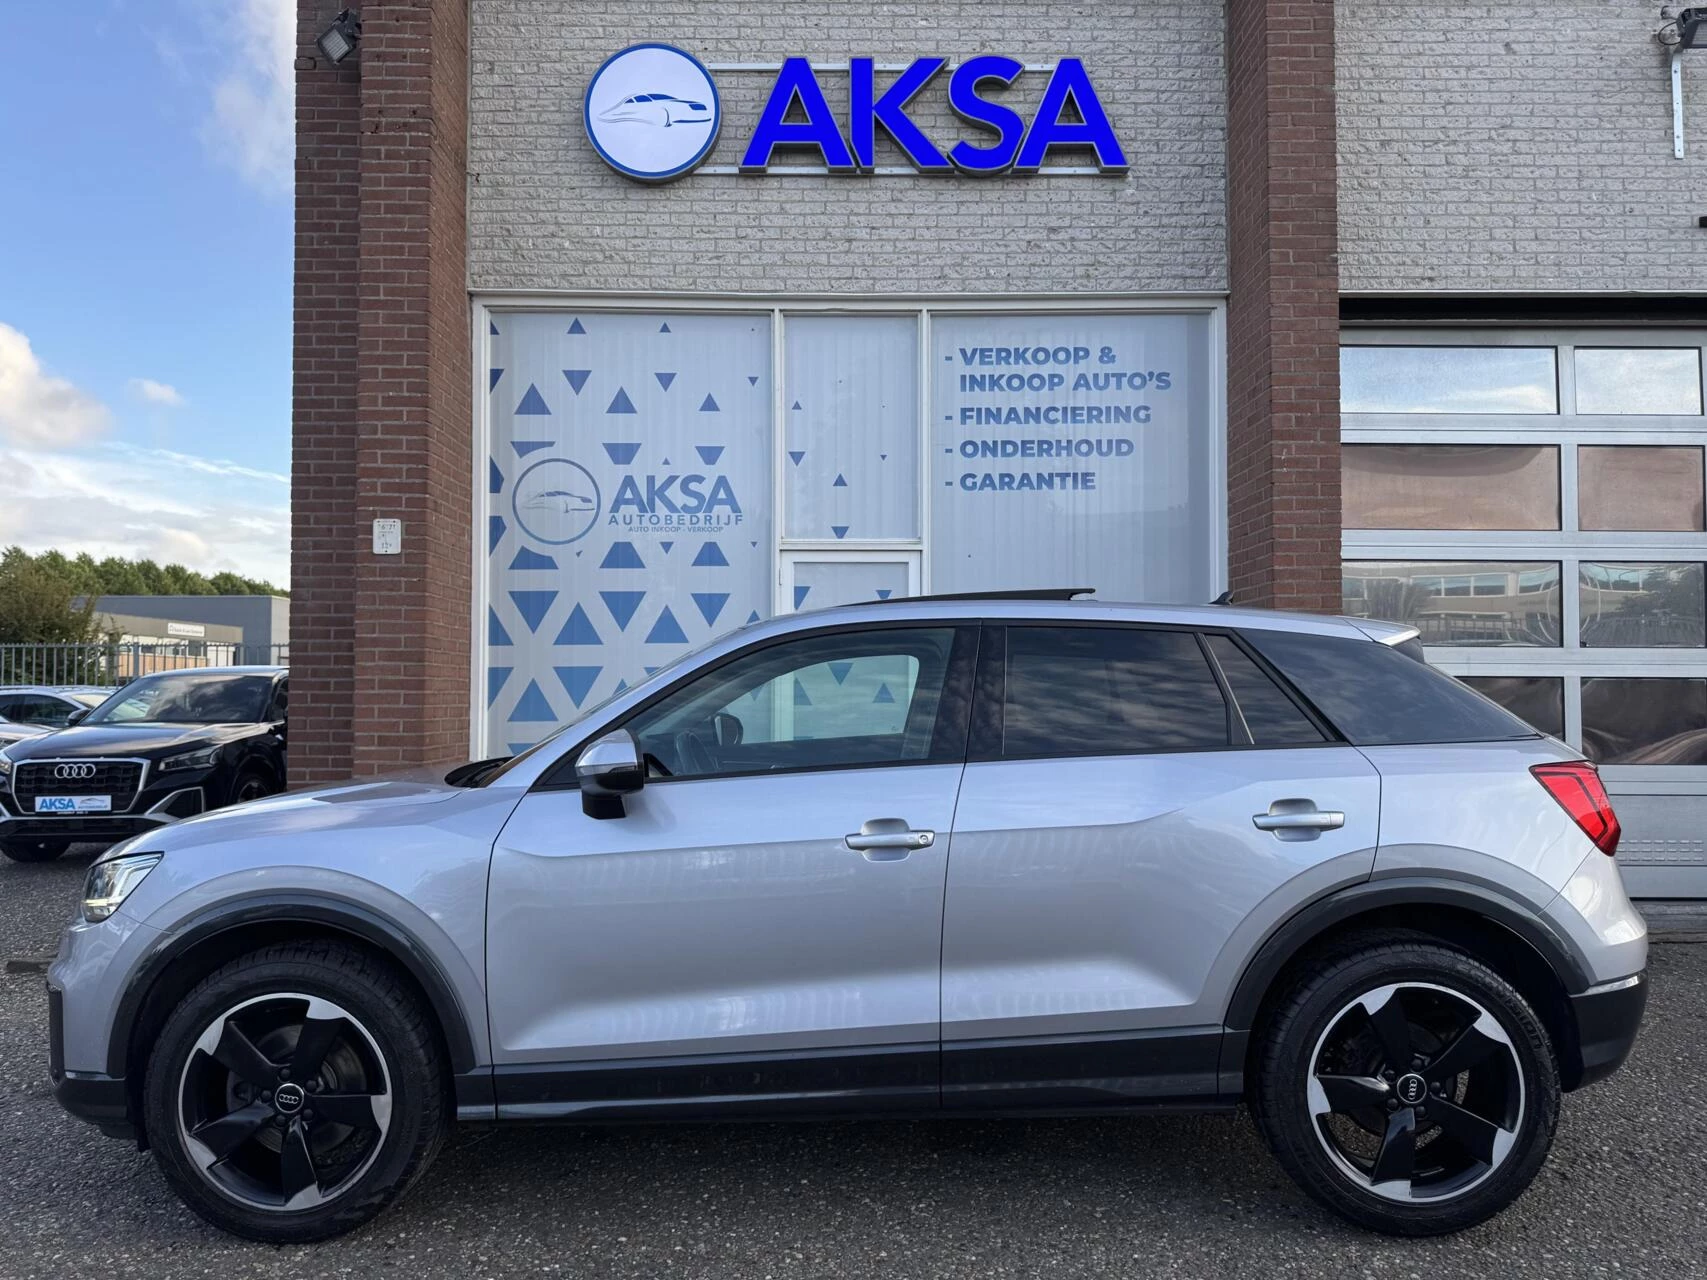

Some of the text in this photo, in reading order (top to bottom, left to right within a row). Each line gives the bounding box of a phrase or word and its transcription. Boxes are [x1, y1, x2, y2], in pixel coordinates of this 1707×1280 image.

[739, 55, 1130, 175] AKSA
[959, 347, 1090, 366] VERKOOP
[1098, 346, 1116, 364] &
[960, 371, 1172, 392] INKOOP AUTO'S
[960, 405, 1151, 425] FINANCIERING
[959, 439, 1134, 458] ONDERHOUD
[959, 472, 1096, 491] GARANTIE
[609, 474, 742, 514] AKSA
[608, 514, 743, 526] AUTOBEDRIJF
[39, 798, 75, 810] AKSA
